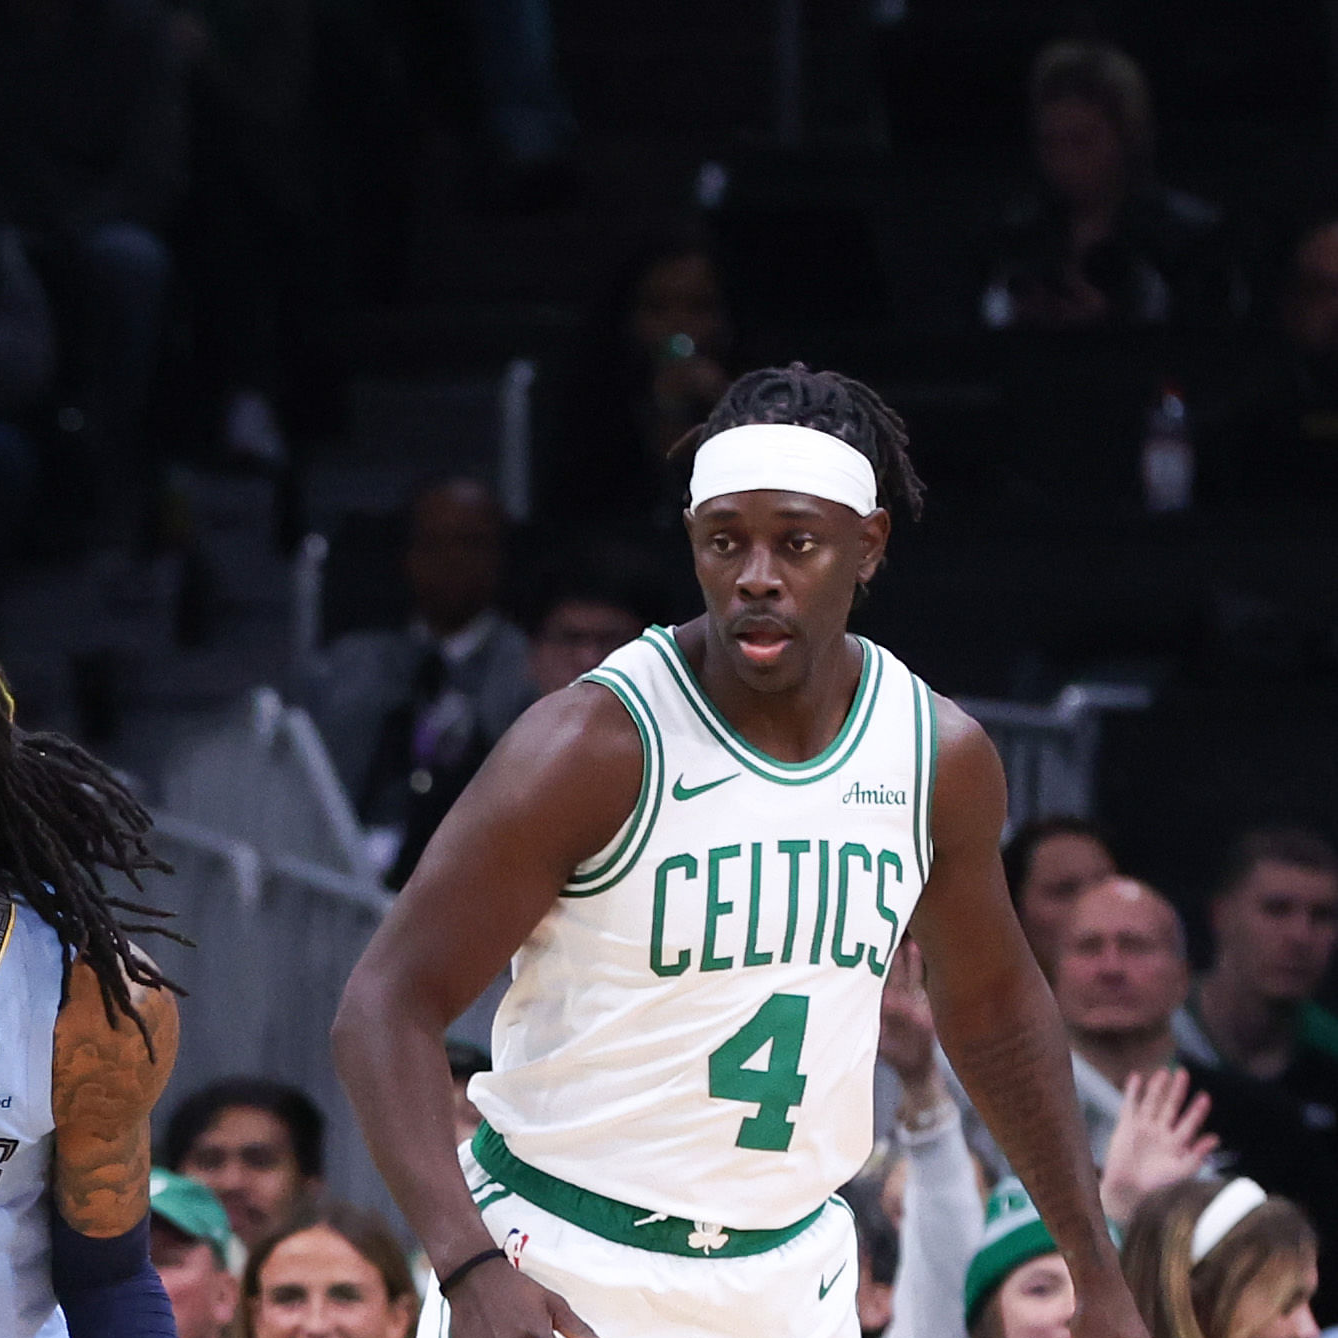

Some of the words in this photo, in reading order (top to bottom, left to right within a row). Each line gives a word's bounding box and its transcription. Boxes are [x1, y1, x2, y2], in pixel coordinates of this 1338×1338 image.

[842, 781, 907, 805] Amica
[650, 839, 904, 978] CELTICS
[708, 992, 811, 1153] 4
